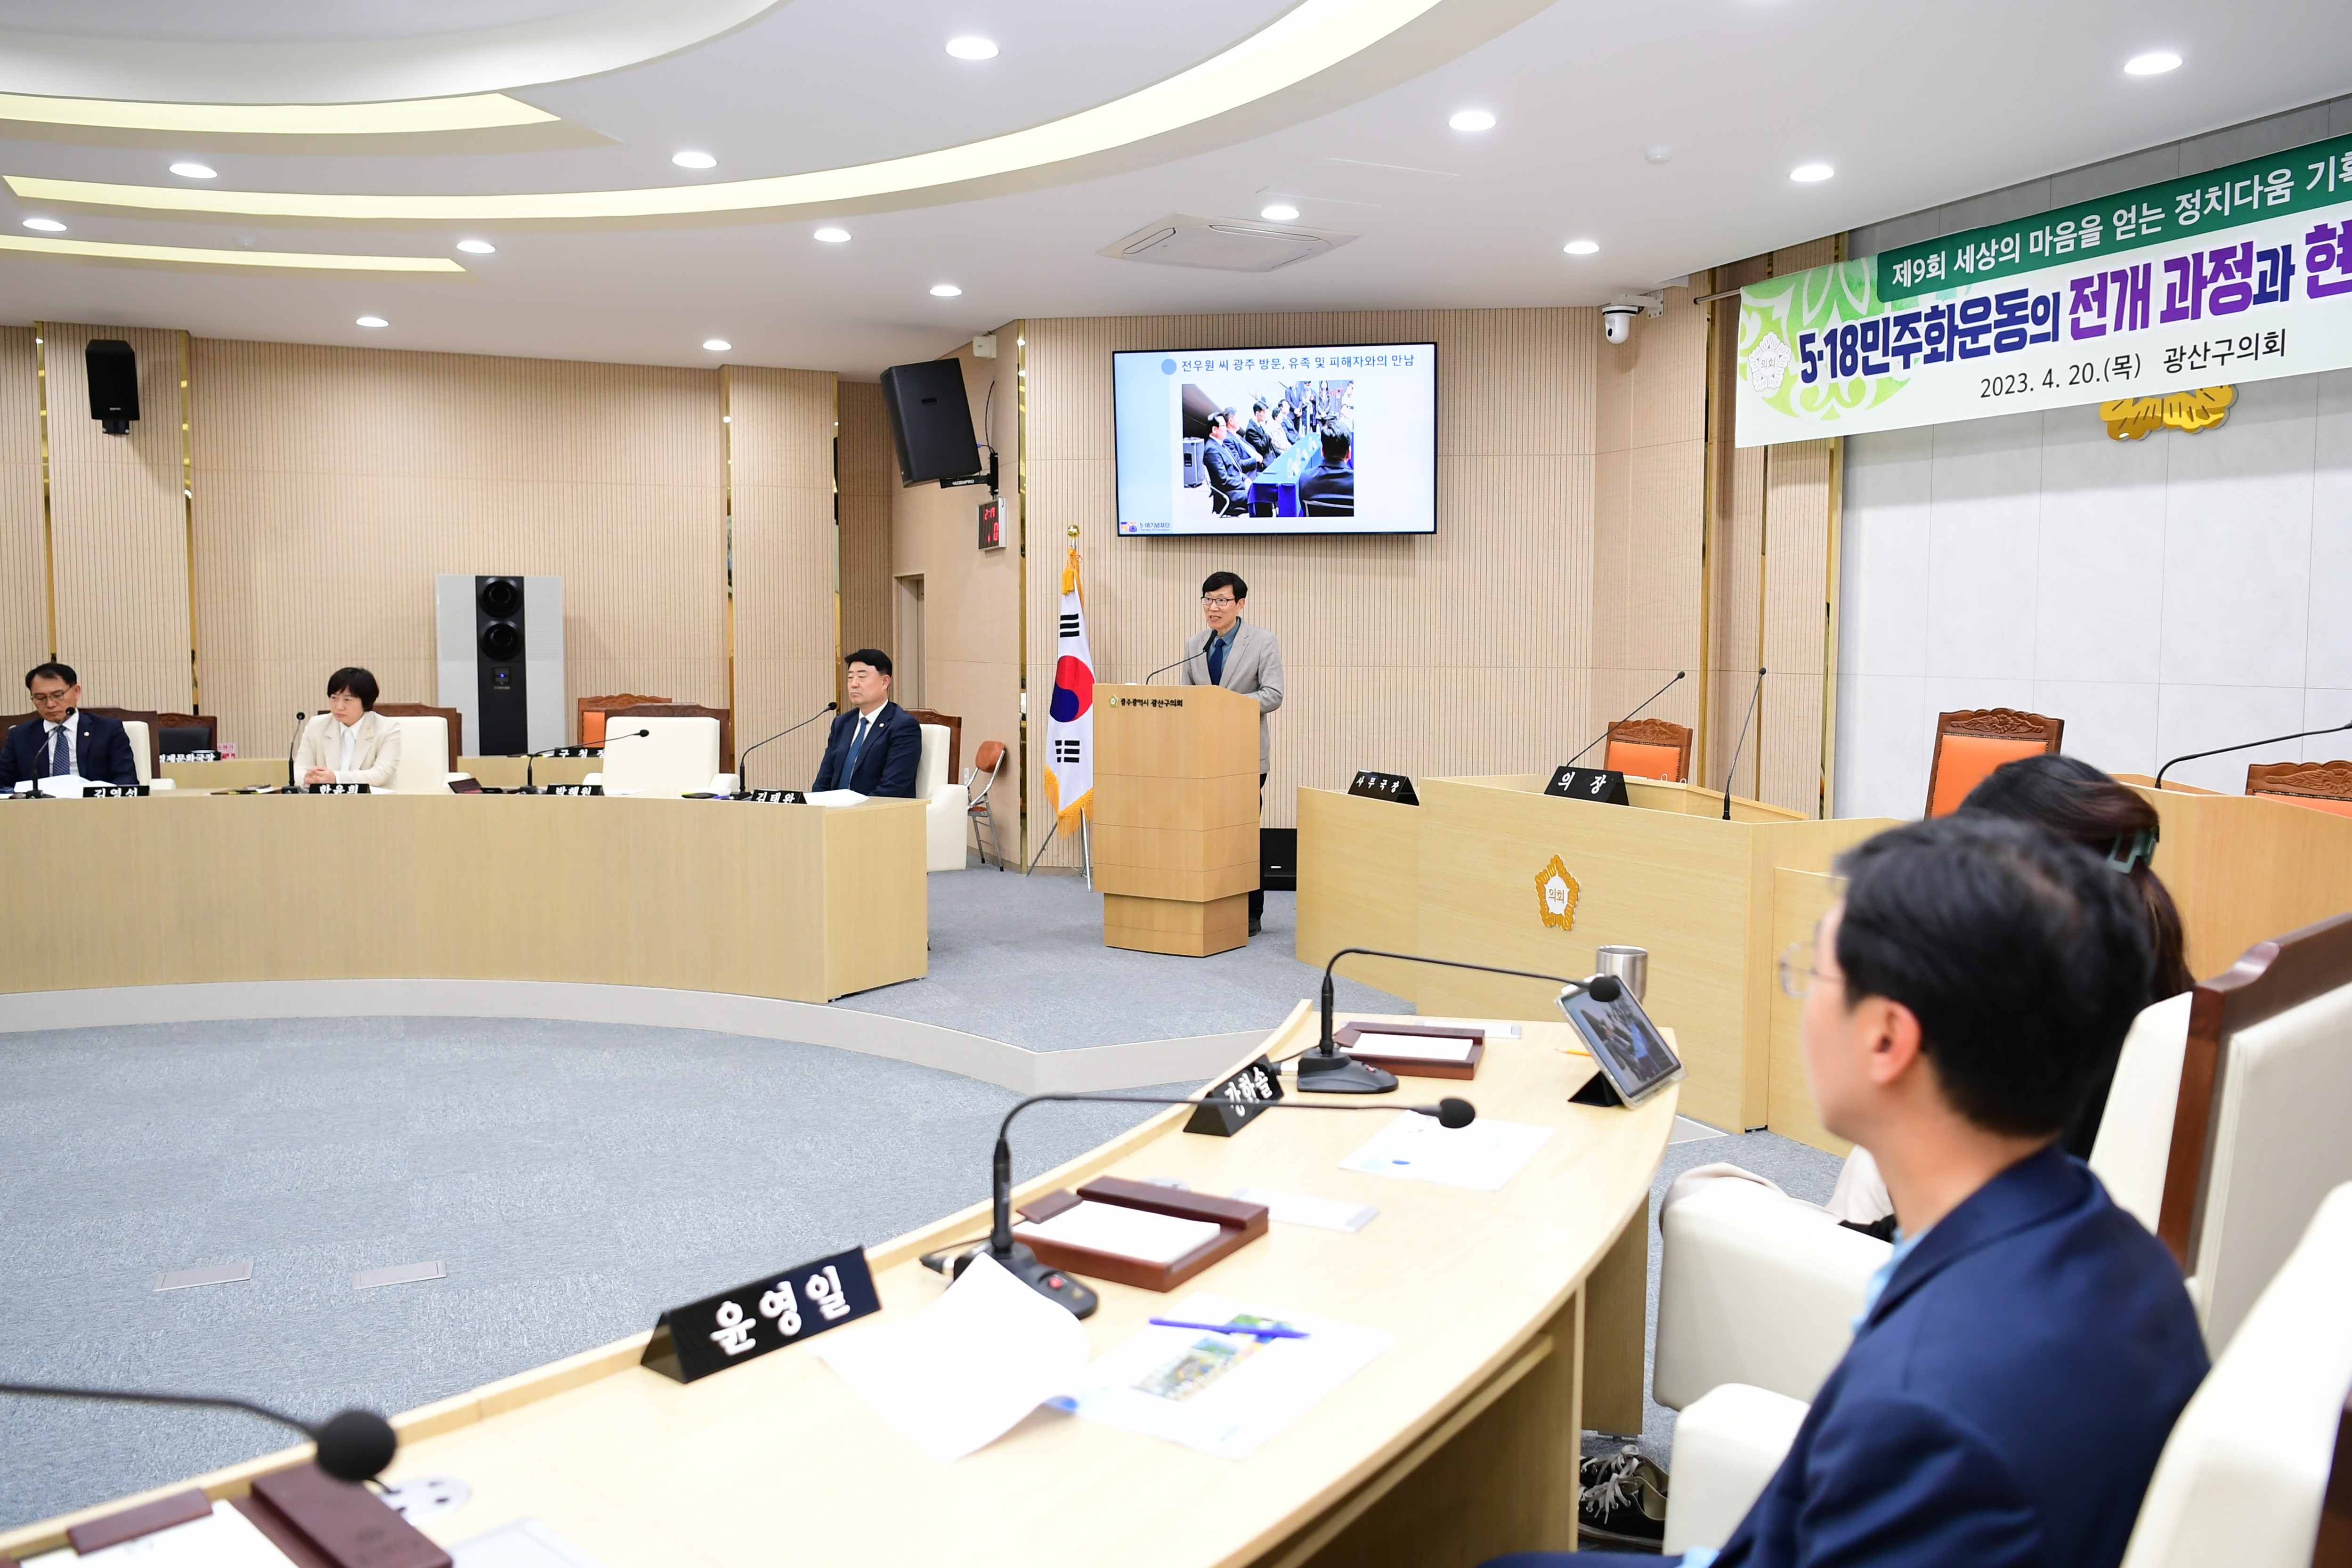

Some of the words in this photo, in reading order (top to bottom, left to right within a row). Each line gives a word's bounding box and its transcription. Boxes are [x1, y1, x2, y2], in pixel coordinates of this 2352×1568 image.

[1892, 251, 1946, 288] 제9회
[1953, 233, 2020, 274] 세상의
[2029, 214, 2104, 257] 마음을
[2112, 203, 2165, 241] 얻는
[2174, 168, 2295, 226] 정치다움
[2068, 262, 2152, 341] 전개
[2159, 241, 2296, 324] 과정과
[1182, 360, 1215, 372] 전우원
[1219, 359, 1229, 371] 씨
[1233, 358, 1255, 371] 광주
[1259, 358, 1285, 370] 방문,
[1288, 357, 1311, 369] 유족
[1315, 357, 1325, 369] 및
[1329, 355, 1387, 368] 피해자와의
[1392, 354, 1415, 367] 만남
[1761, 357, 1776, 369] 의회
[1980, 372, 2034, 398] 2023.
[2042, 368, 2060, 389] 4.
[2163, 328, 2286, 374] 광산구의회
[1120, 698, 1149, 707] 광주광역시
[1151, 699, 1184, 708] 광산구의회
[1355, 775, 1400, 793] 사무국장
[1557, 771, 1607, 794] 의장
[1548, 888, 1565, 904] 의회
[709, 1264, 851, 1356] 윤영일
